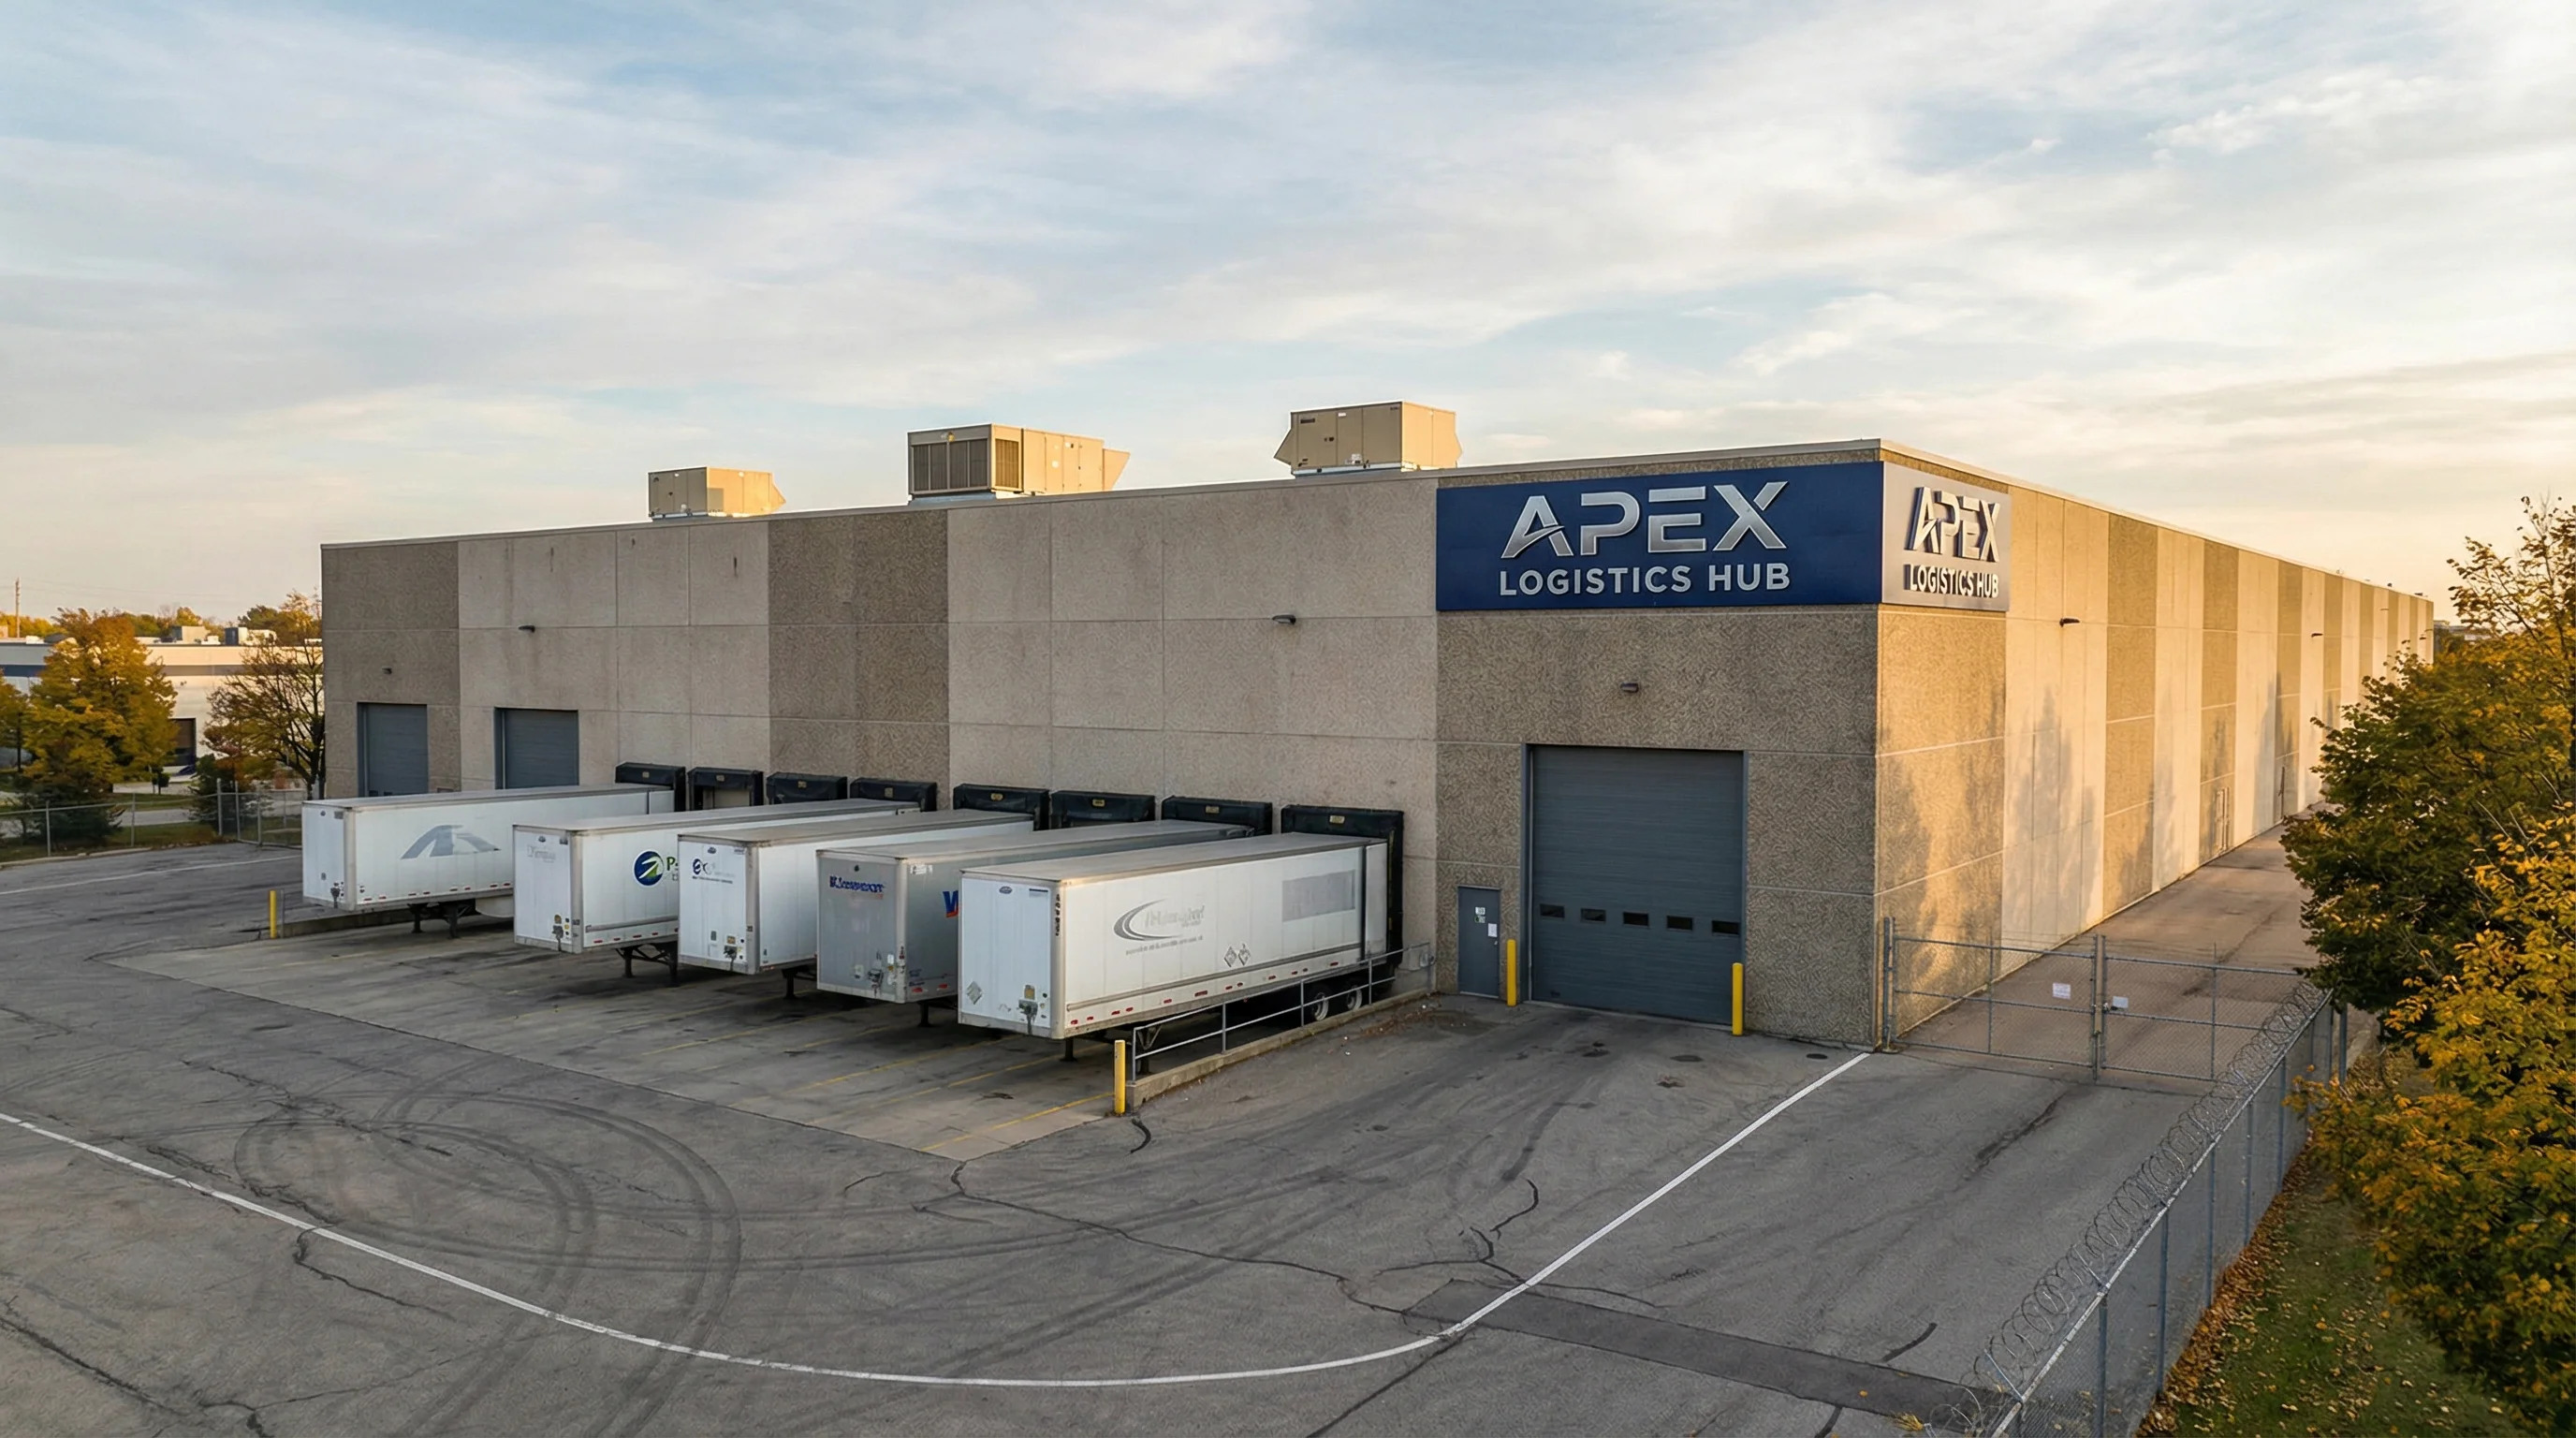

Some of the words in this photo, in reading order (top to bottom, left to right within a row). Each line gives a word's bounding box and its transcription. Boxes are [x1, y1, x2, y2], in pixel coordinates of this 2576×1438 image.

[1500, 481, 1789, 559] APEX
[1907, 486, 2001, 563] APEX
[1500, 565, 1691, 596] LOGISTICS
[1708, 563, 1791, 592] HUB
[1908, 564, 1974, 596] LOGISTICS
[1976, 572, 1999, 598] HUB
